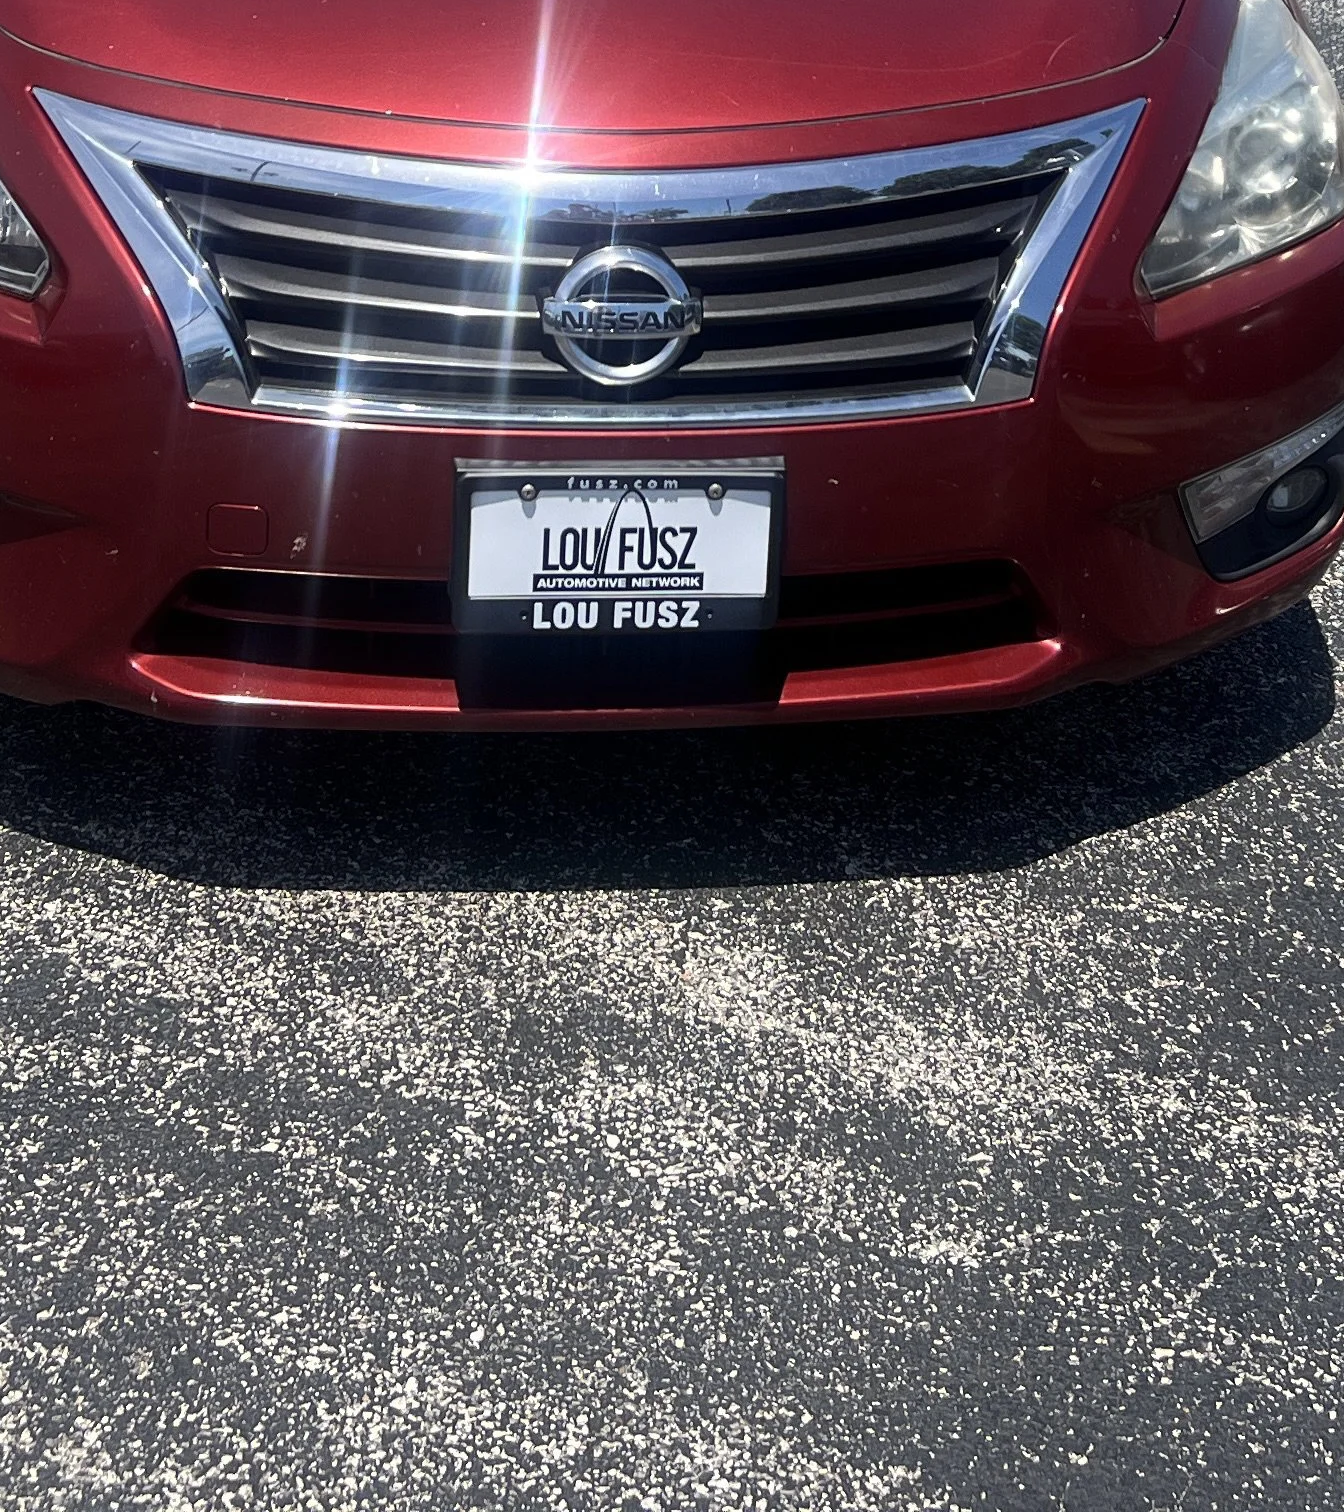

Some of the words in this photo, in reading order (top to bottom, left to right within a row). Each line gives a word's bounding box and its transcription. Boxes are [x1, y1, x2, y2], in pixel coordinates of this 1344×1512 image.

[560, 309, 686, 330] NISSAN
[567, 477, 678, 489] fusz.com
[542, 527, 602, 571] LOU
[617, 526, 698, 571] FUSZ
[536, 577, 627, 589] AUTOMOTIVE
[631, 576, 700, 588] NETWORK
[533, 601, 599, 630] LOU
[613, 600, 700, 629] FUSZ
